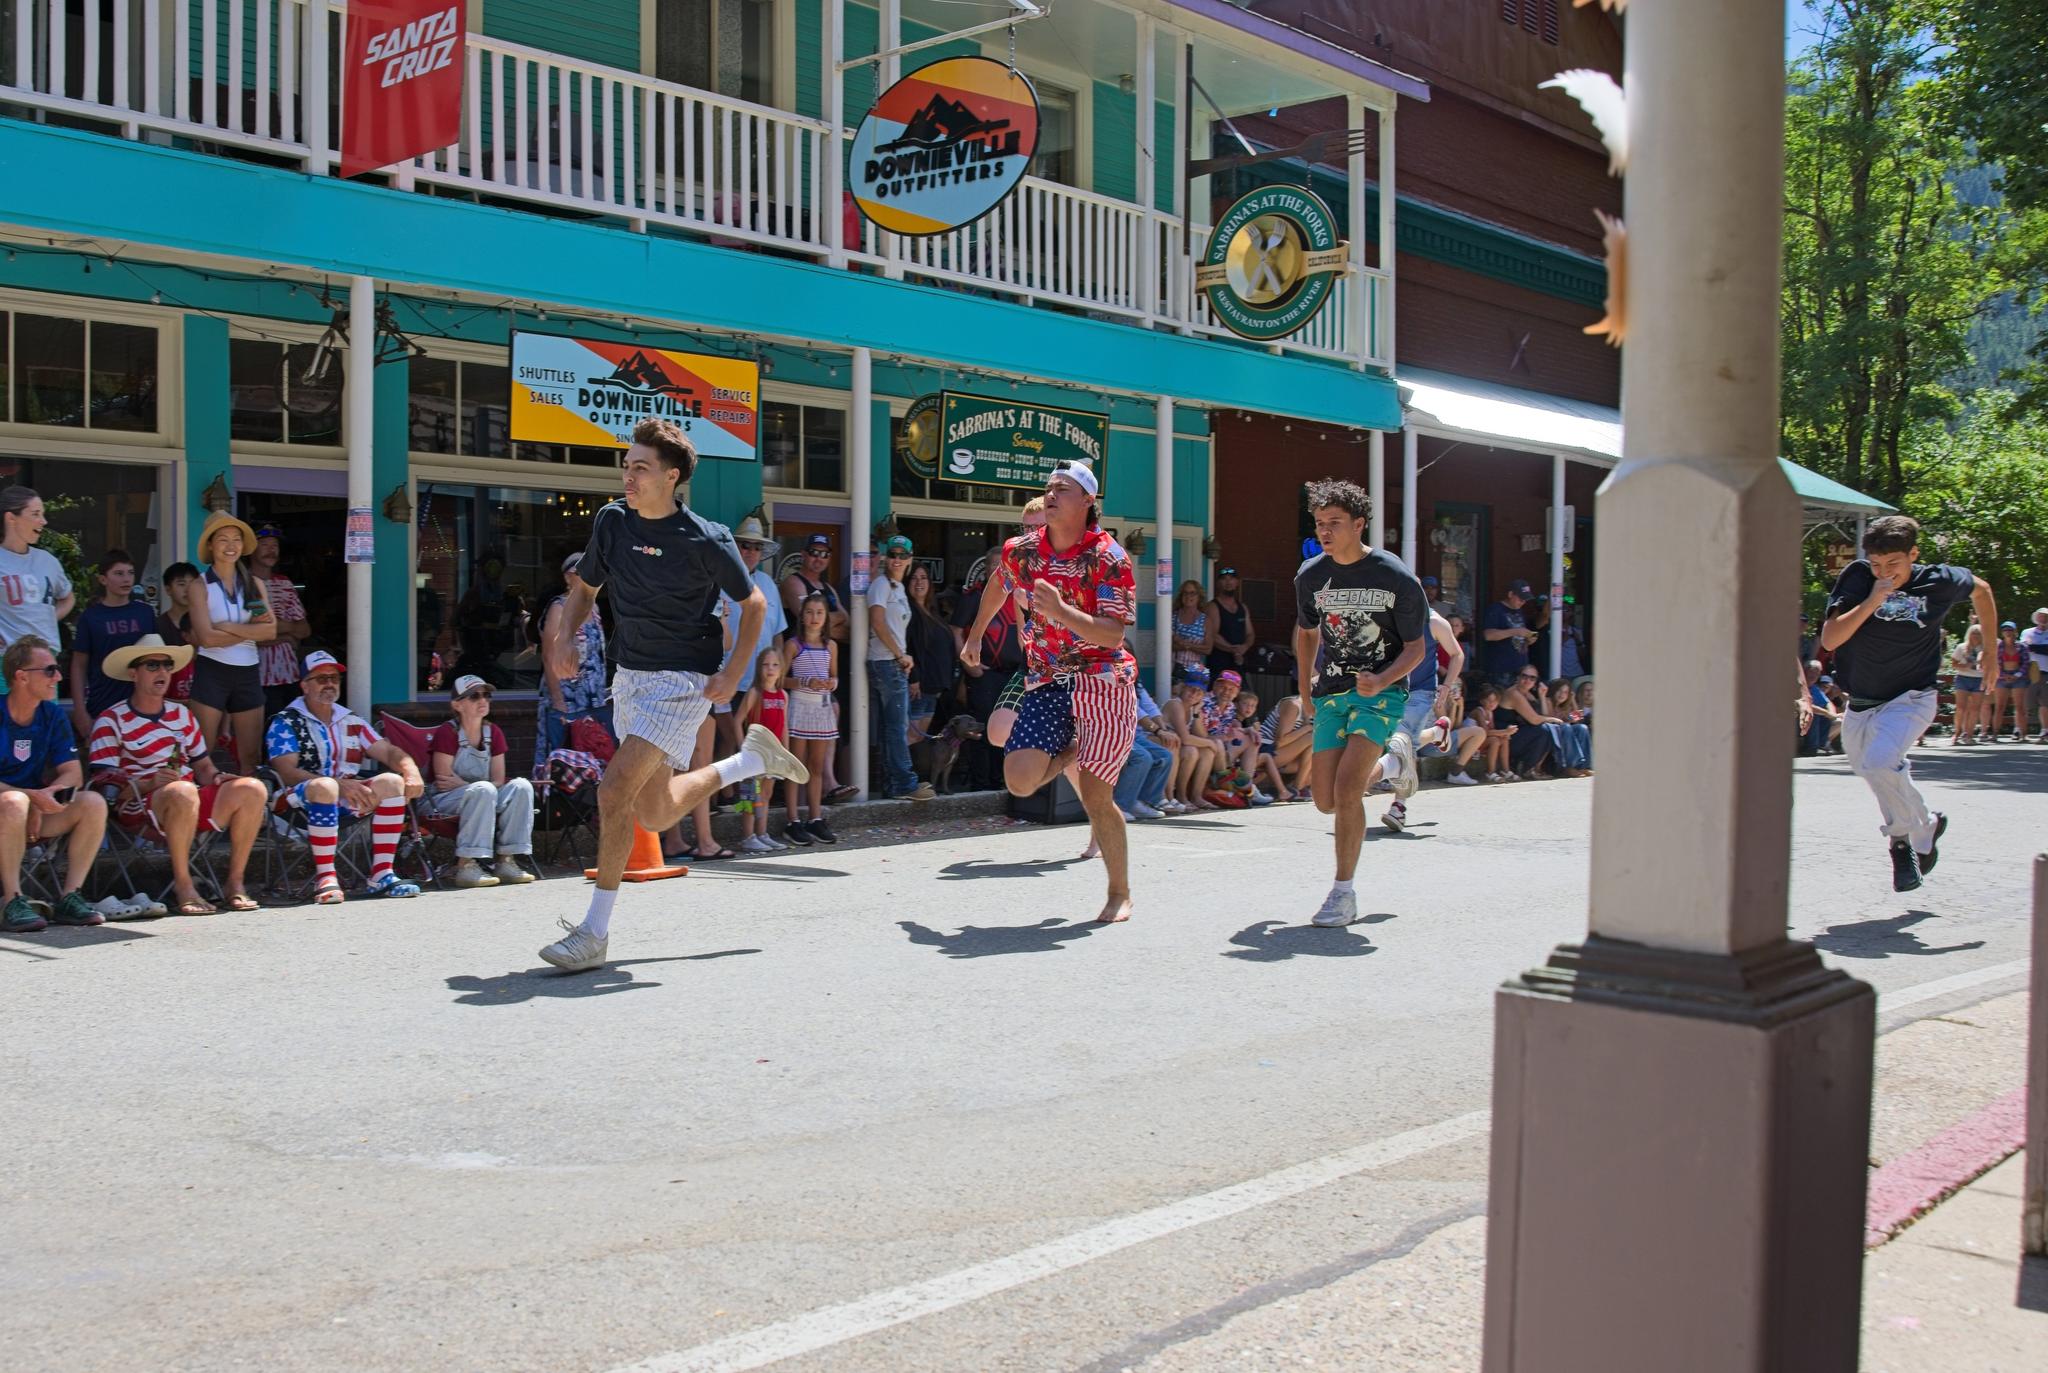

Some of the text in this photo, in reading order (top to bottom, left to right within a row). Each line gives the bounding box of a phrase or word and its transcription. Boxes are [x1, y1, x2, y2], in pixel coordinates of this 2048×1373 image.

[362, 6, 457, 66] SANTA
[381, 36, 458, 88] CRUZ
[864, 130, 1021, 184] DOWNIEVILLE
[876, 161, 1004, 198] OUTFITTERS
[1213, 194, 1329, 261] SABRINA'S AT THE FORKS
[1216, 280, 1323, 328] RESTAURANT ON THE RIVER
[519, 366, 576, 384] SHUTTLES
[530, 391, 564, 406] SALES
[578, 387, 703, 419] DOWNIEVILLE
[711, 388, 751, 403] SERVICE
[589, 411, 692, 432] OUTFIRS
[710, 408, 751, 425] REPAIRS
[948, 409, 1100, 460] SABRINA'S AT THE FORKS
[1012, 432, 1045, 453] Serving
[2, 574, 53, 605] USA
[106, 619, 140, 634] USA
